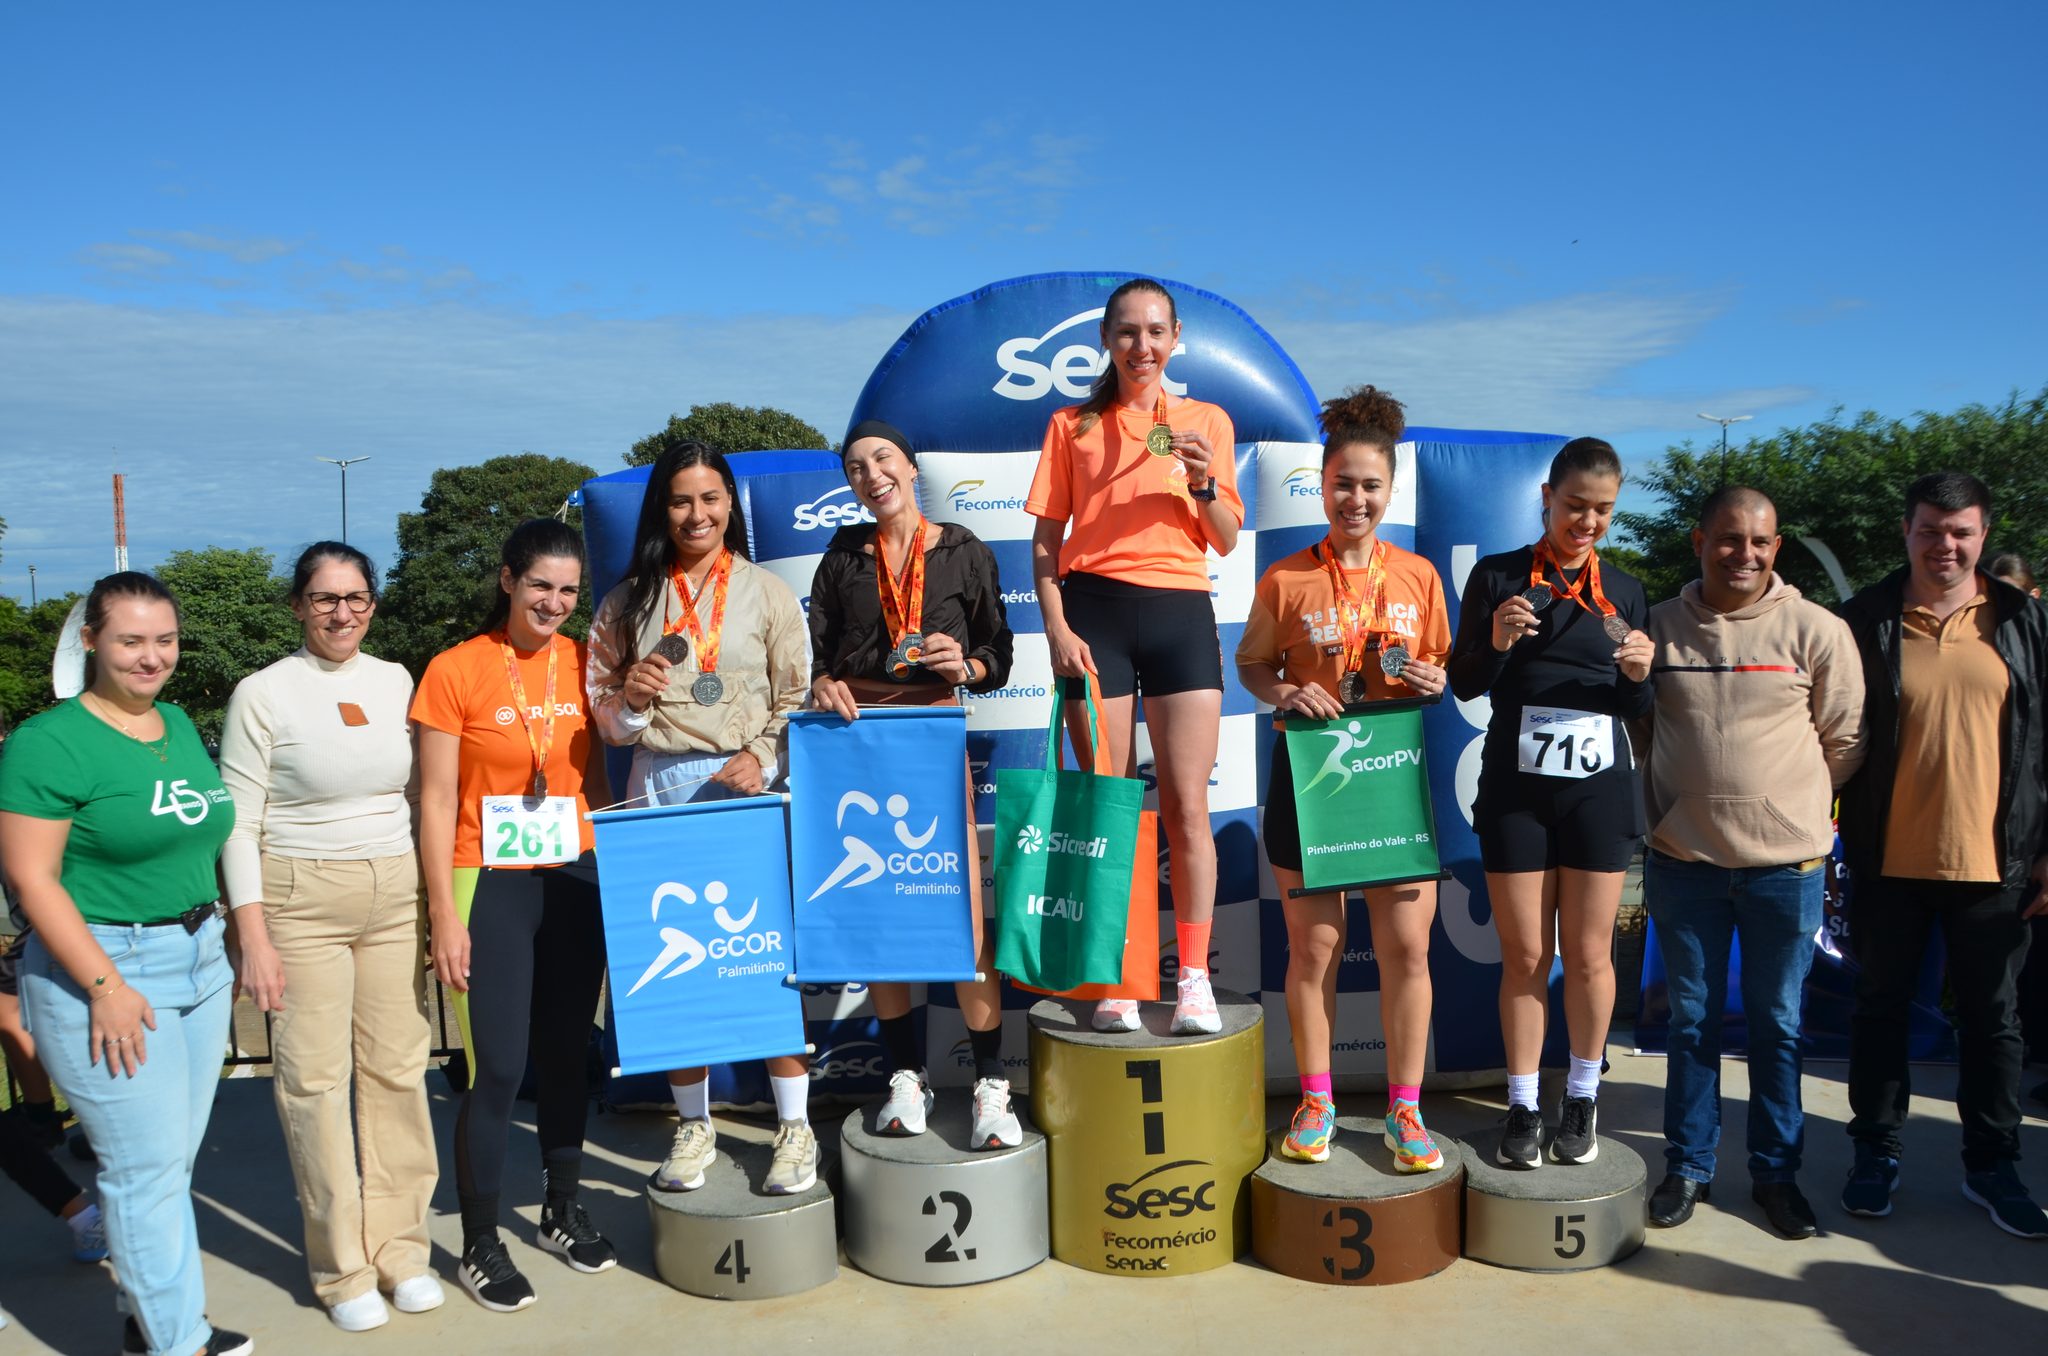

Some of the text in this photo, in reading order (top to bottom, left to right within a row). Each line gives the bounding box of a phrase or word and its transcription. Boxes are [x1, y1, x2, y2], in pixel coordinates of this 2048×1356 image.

[1351, 748, 1422, 773] acorPV
[496, 821, 563, 859] 261
[1046, 832, 1108, 859] Sicredi
[1307, 841, 1367, 856] Pinheirinho
[1369, 838, 1383, 849] do
[1384, 835, 1407, 847] Vale
[1415, 832, 1430, 843] RS
[887, 851, 960, 875] GCOR
[895, 882, 961, 895] Palmitinho
[1027, 892, 1084, 922] ICATU
[708, 930, 783, 960] GCOR
[717, 960, 785, 978] Palmitinho
[1125, 1059, 1165, 1155] 1
[922, 1191, 977, 1263] 2
[1104, 1227, 1216, 1250] Fecomércio
[1554, 1214, 1586, 1259] 5
[1322, 1206, 1375, 1280] 3
[714, 1239, 751, 1284] 4
[1105, 1253, 1169, 1271] Senac
